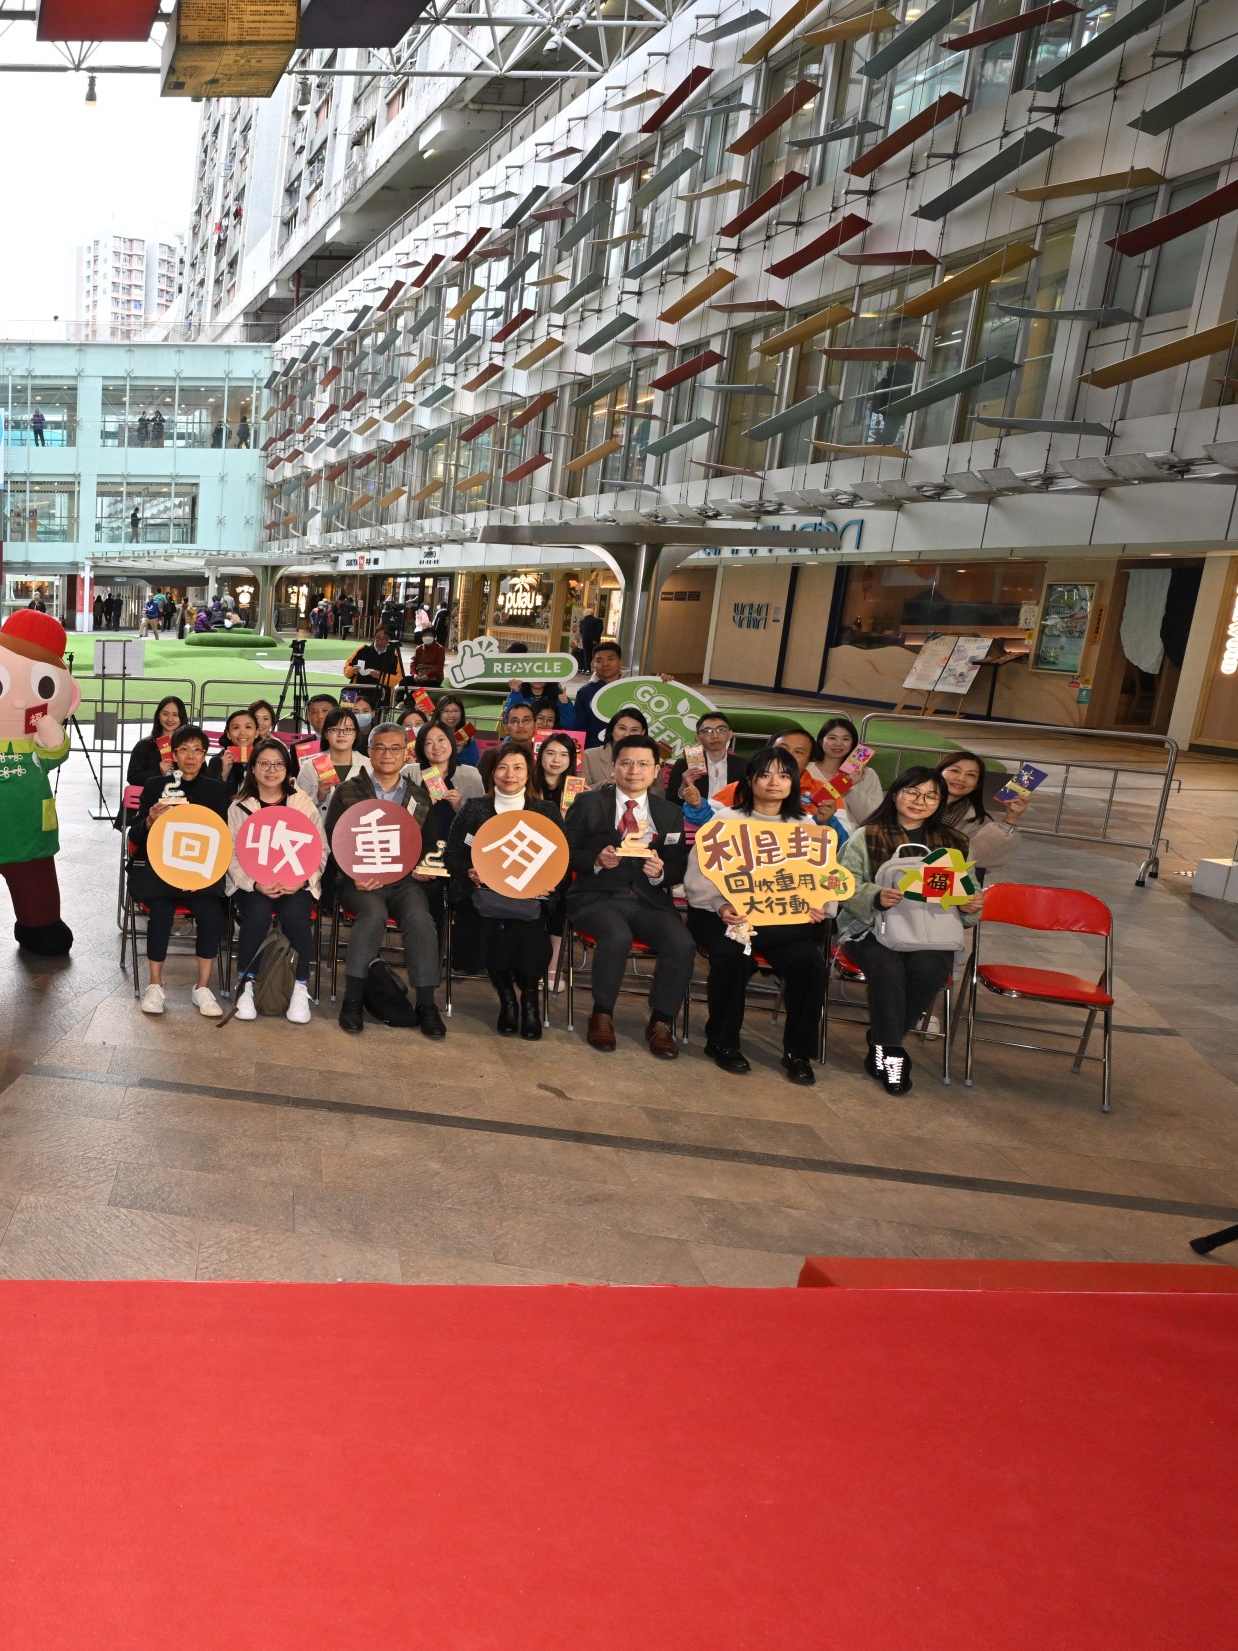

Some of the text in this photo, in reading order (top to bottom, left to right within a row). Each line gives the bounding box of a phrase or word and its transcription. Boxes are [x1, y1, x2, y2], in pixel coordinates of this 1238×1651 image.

[505, 588, 535, 613] pulau
[636, 685, 670, 713] GO
[162, 821, 220, 880] 回
[245, 819, 313, 876] 收
[351, 809, 403, 874] 重
[482, 819, 558, 891] 用
[702, 820, 832, 873] 利是封
[724, 868, 816, 894] 回收重用
[927, 873, 949, 891] 福
[743, 897, 810, 916] 大行動
